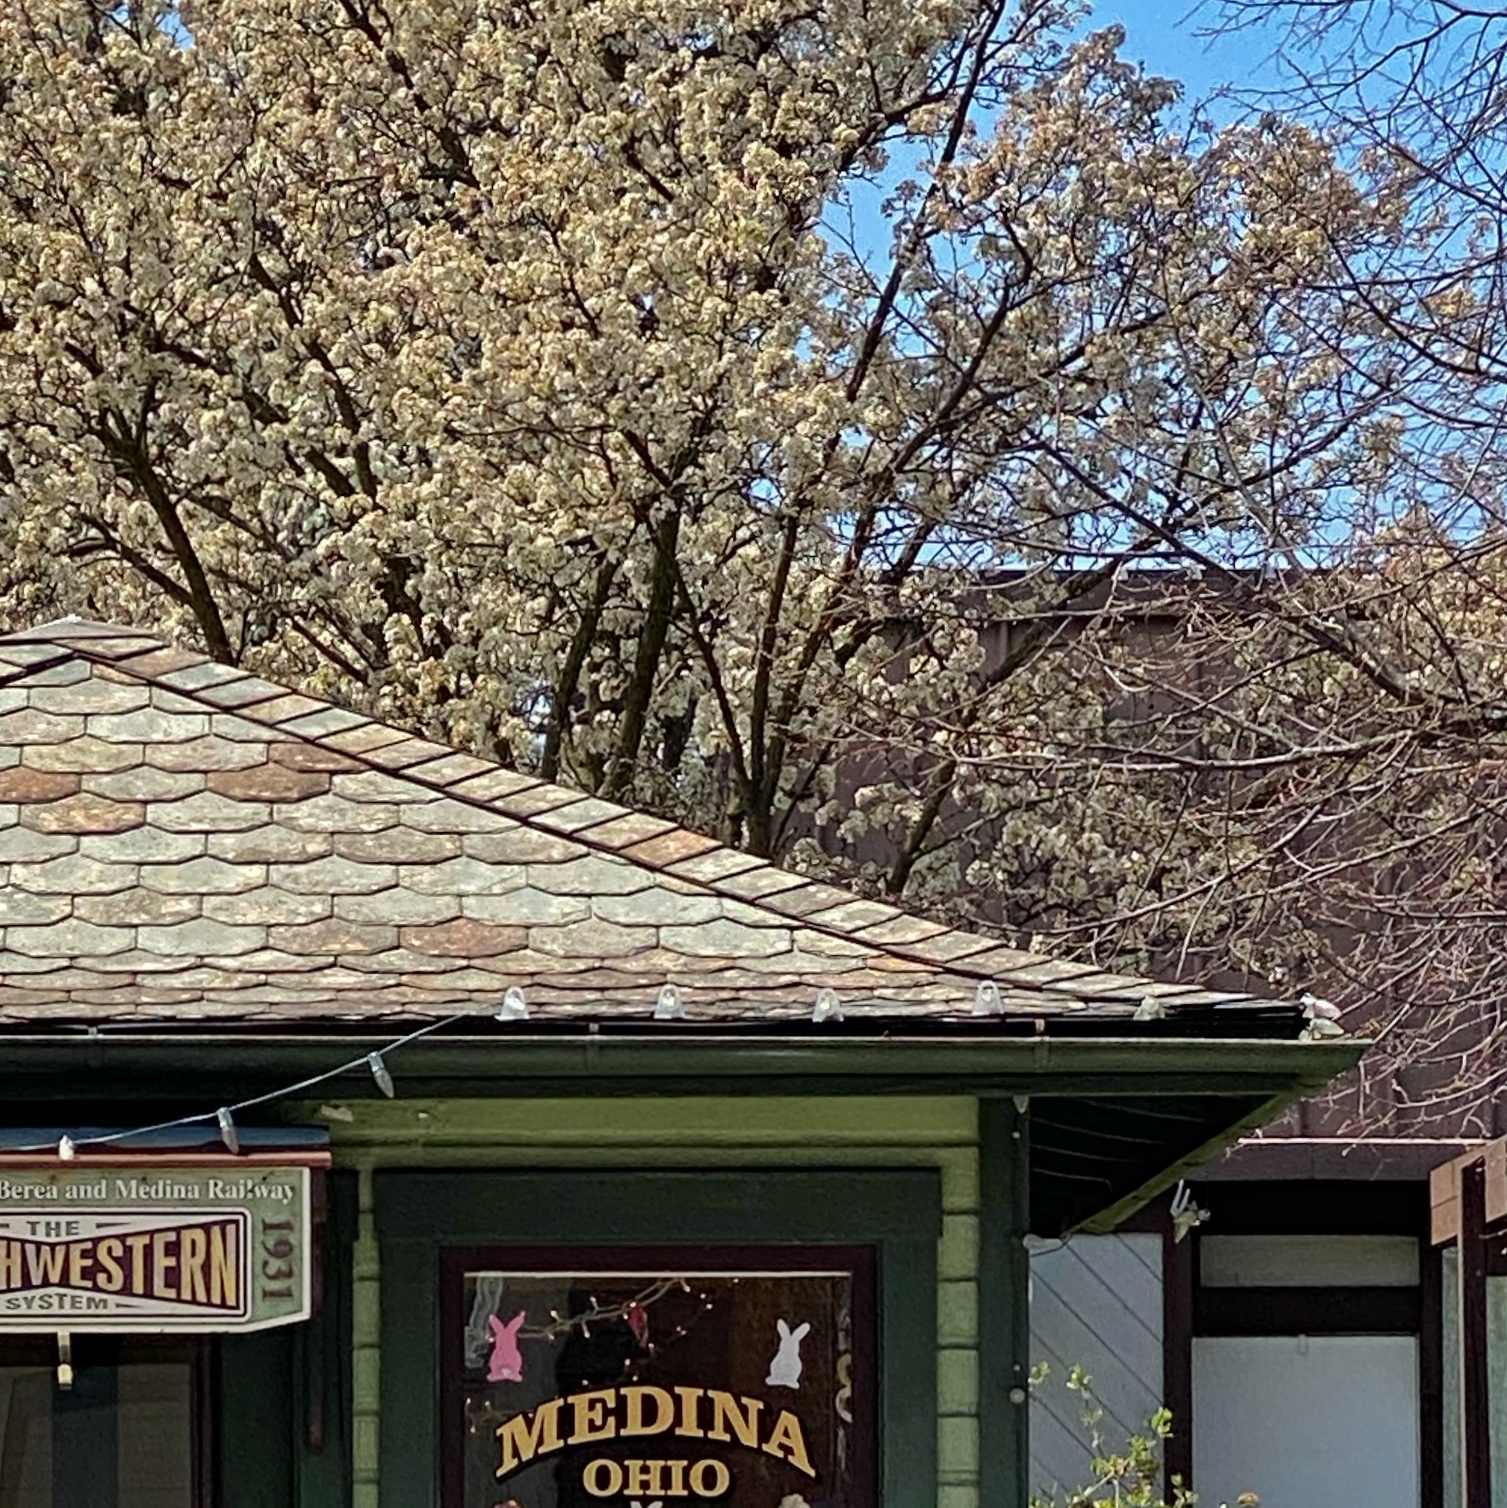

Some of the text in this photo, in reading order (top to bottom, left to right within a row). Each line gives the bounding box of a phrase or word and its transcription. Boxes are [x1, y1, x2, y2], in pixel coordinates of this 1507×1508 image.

[65, 1179, 107, 1200] and
[115, 1178, 200, 1200] Medina
[208, 1178, 294, 1205] Railway
[26, 1221, 80, 1237] THE
[261, 1218, 294, 1302] 1931
[5, 1293, 109, 1310] SYSTEM
[495, 1385, 816, 1478] MEDINA
[582, 1458, 730, 1497] OHIO
